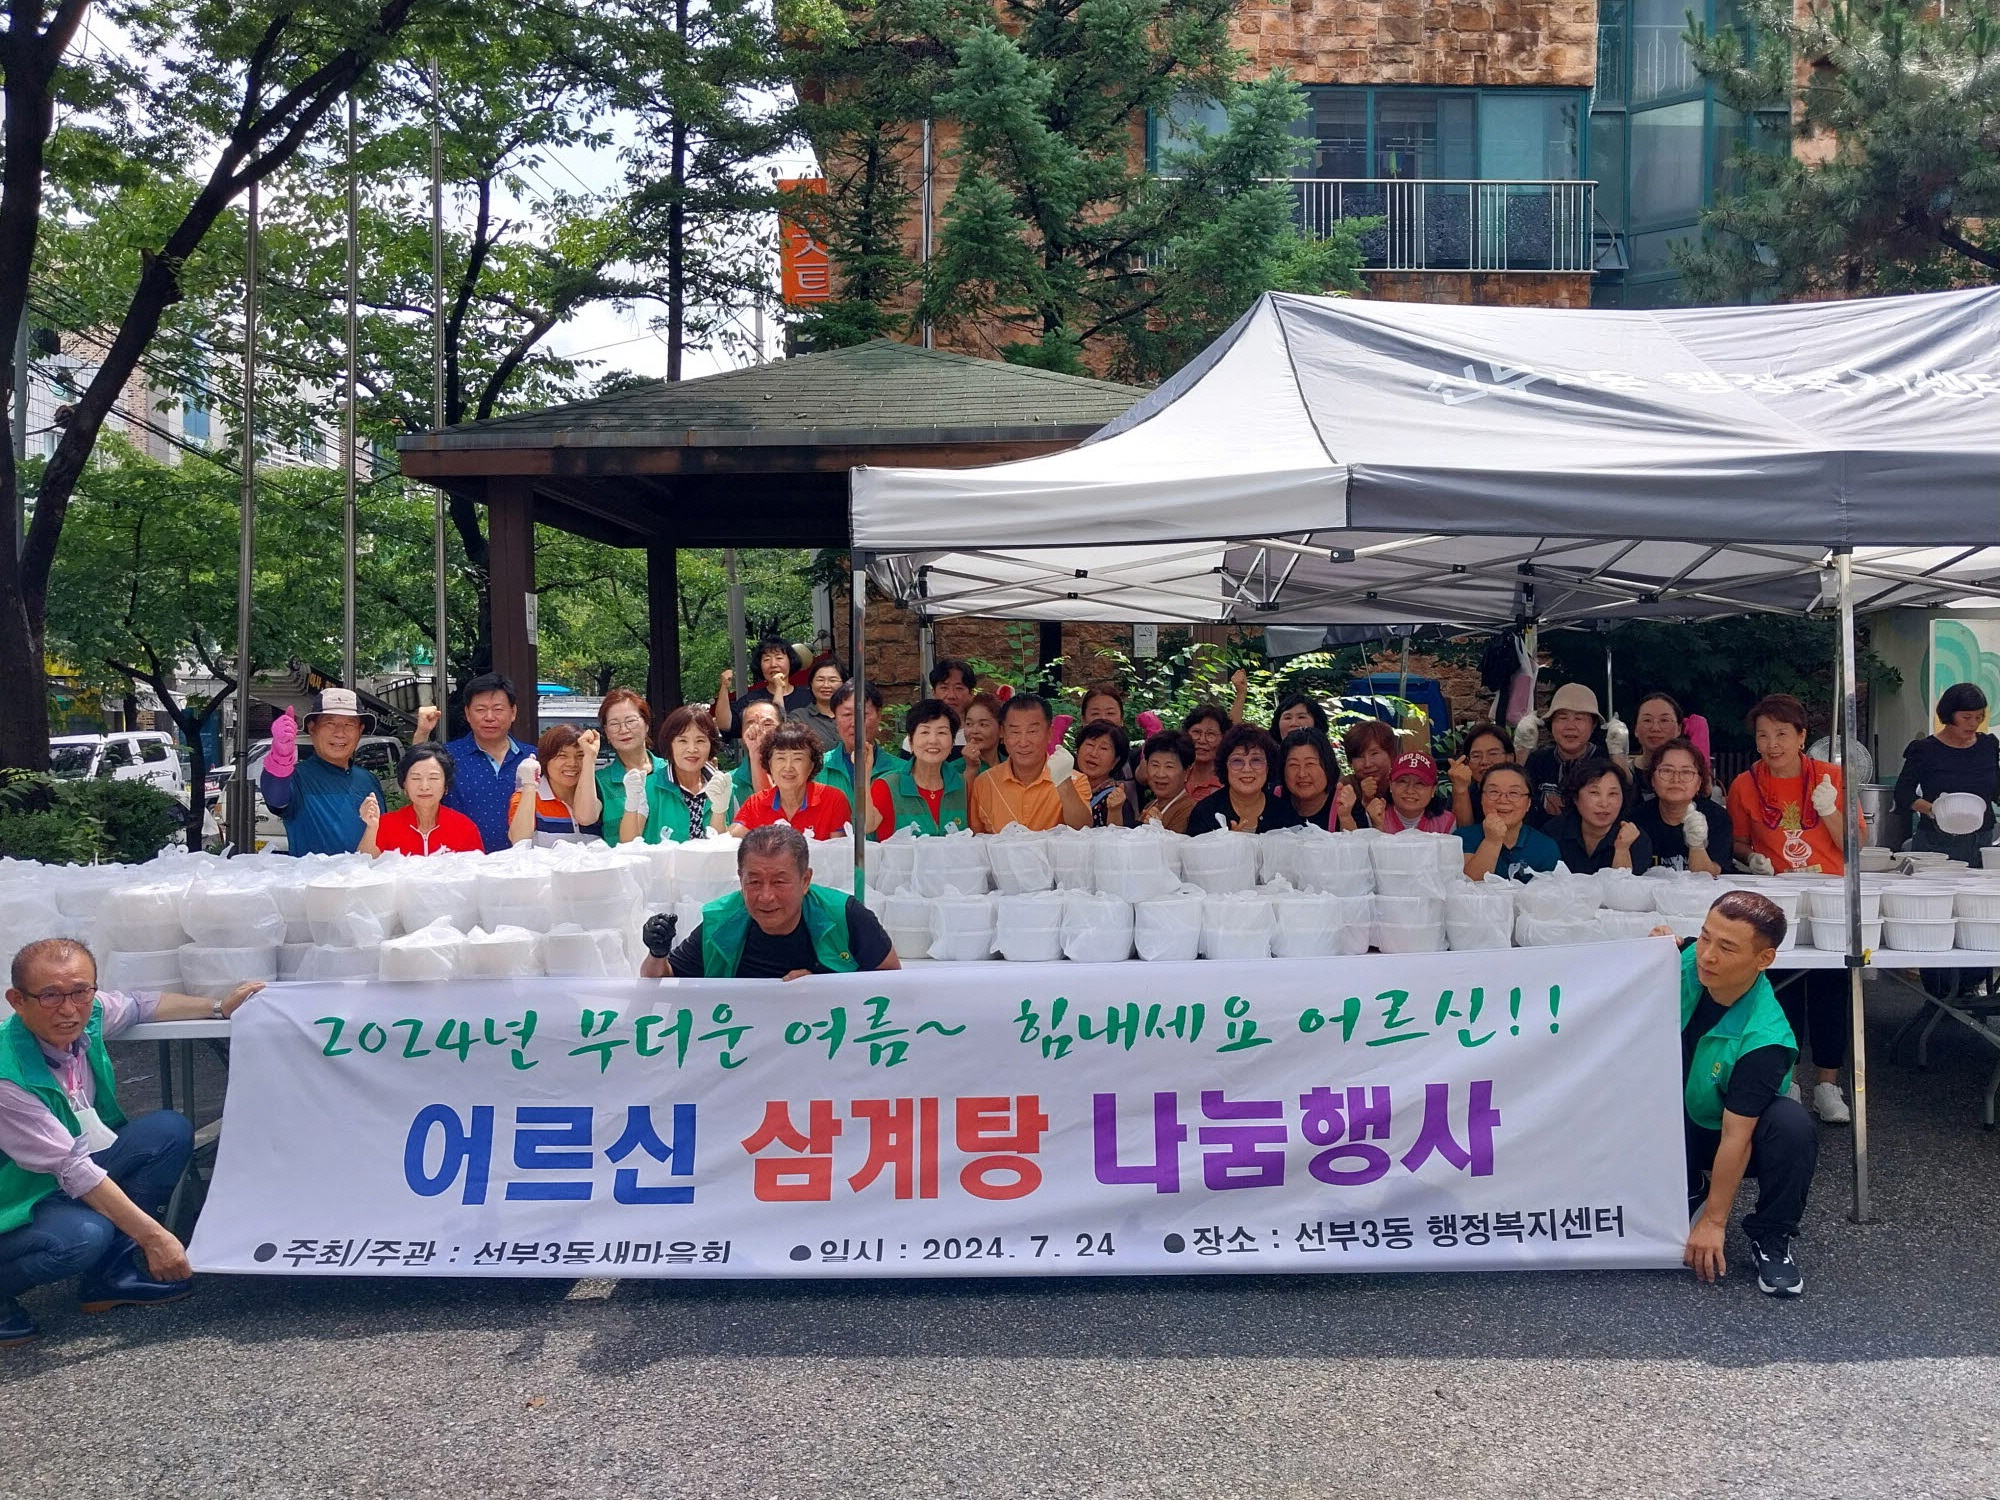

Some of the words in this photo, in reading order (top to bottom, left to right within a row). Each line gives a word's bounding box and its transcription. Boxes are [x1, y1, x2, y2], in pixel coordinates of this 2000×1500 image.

[1398, 753, 1414, 764] RED
[1415, 753, 1431, 768] SOX
[1409, 758, 1419, 768] B
[313, 1008, 540, 1071] 2024년
[567, 1003, 754, 1074] 무더운
[783, 996, 967, 1068] 여름~
[1013, 995, 1273, 1060] 힘내세요
[1298, 984, 1563, 1050] 어르신!!
[403, 1102, 698, 1206] 어르신
[740, 1094, 1050, 1203] 삼계탕
[1092, 1080, 1502, 1195] 나눔행사
[1191, 1225, 1260, 1256] 장소
[1294, 1217, 1415, 1253] 선부3동
[1425, 1205, 1626, 1249] 행정복지센터
[281, 1238, 437, 1267] 주최/주관
[472, 1240, 732, 1266] 선부3동새마을회
[819, 1238, 884, 1263] 일시
[922, 1236, 1015, 1260] 2024.
[1075, 1232, 1116, 1257] 24
